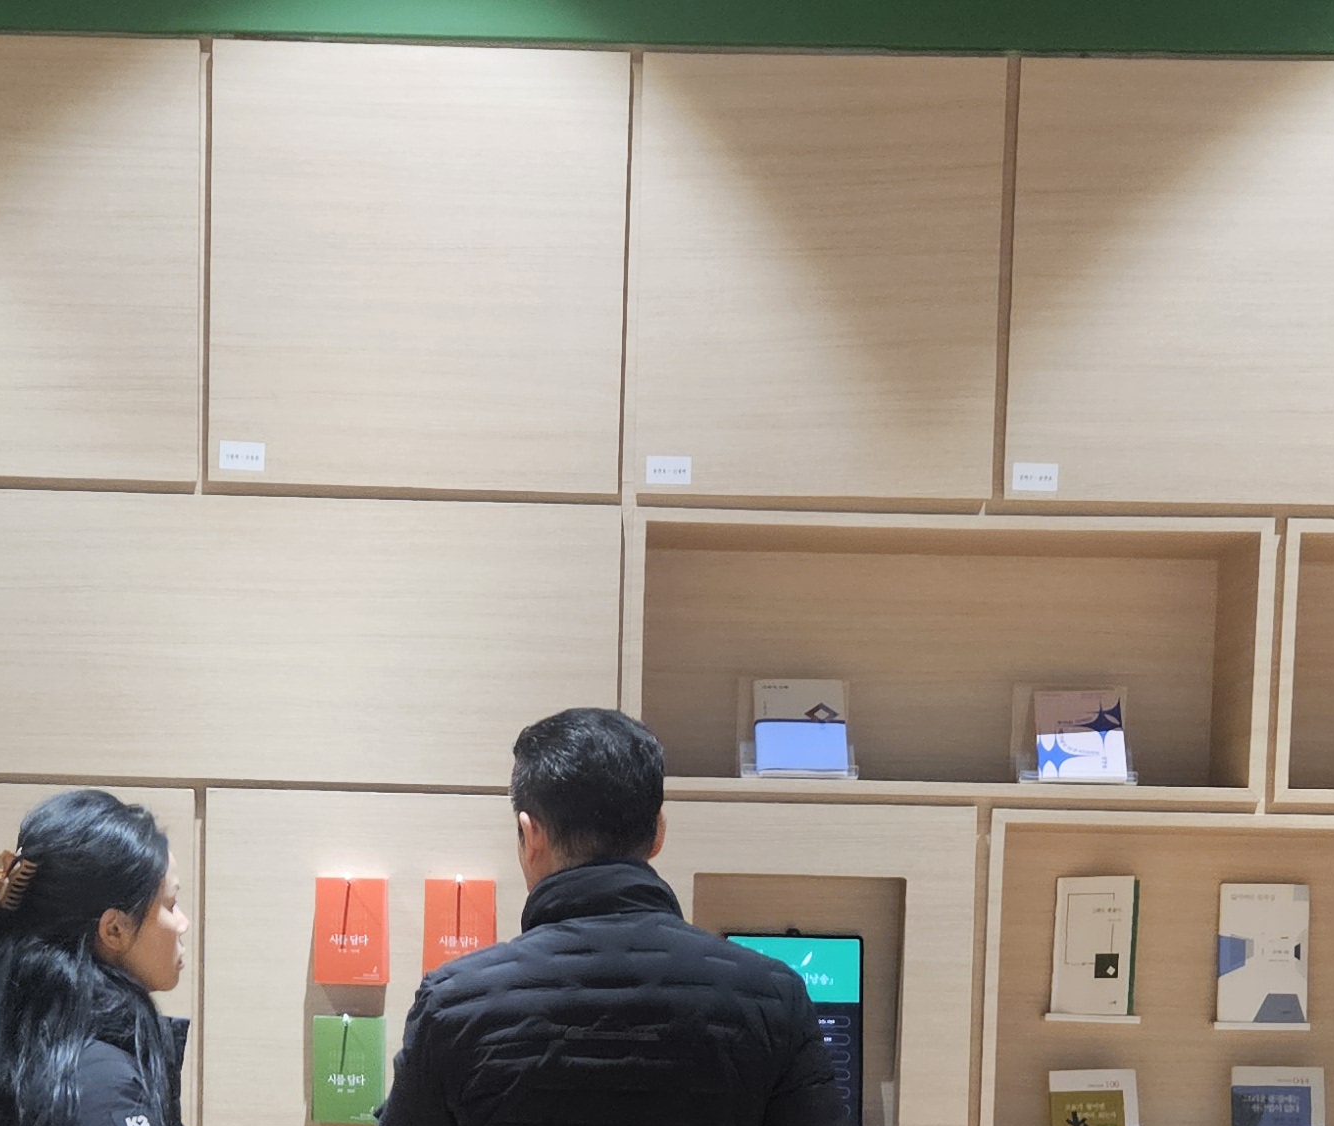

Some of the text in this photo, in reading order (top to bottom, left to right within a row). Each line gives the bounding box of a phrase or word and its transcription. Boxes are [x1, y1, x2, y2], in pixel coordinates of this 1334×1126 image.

[329, 933, 369, 946] 시를 담다
[439, 935, 479, 948] 시를 담다
[327, 1073, 366, 1086] 시를 담다
